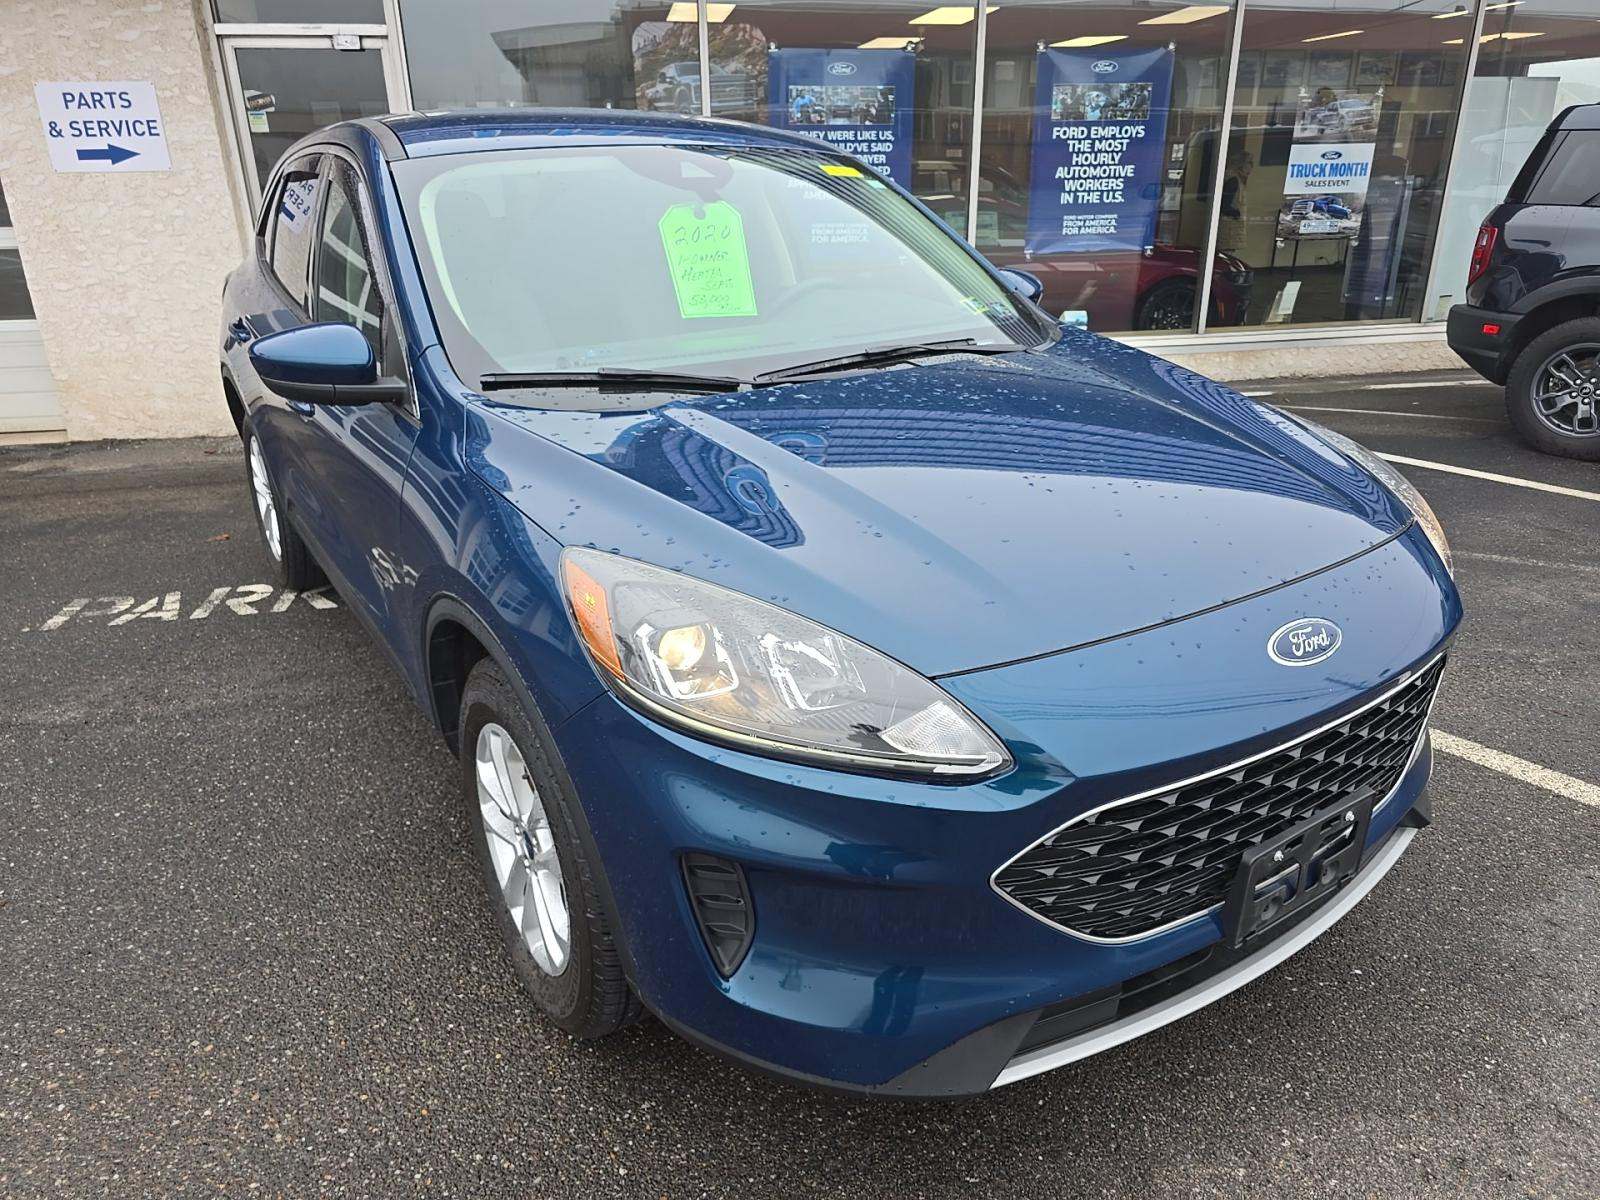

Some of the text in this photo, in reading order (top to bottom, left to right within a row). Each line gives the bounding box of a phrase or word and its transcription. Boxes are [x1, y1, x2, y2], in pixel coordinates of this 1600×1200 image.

[62, 91, 132, 110] PARTS
[48, 119, 160, 138] & SERVICE
[1052, 126, 1146, 139] FORD EMPLOYS
[827, 130, 855, 141] WERE
[857, 130, 877, 141] LIKE
[879, 130, 895, 142] US,
[870, 142, 893, 152] SAID
[1067, 139, 1129, 152] THE MOST
[1072, 152, 1121, 165] HOURLY
[1055, 165, 1135, 178] AUTOMOTIVE
[1290, 162, 1368, 178] TRUCK MONTH
[1064, 179, 1123, 191] WORKERS
[1060, 191, 1124, 205] IN THE U.S.
[674, 225, 732, 244] 2020
[1062, 227, 1079, 235] FOR
